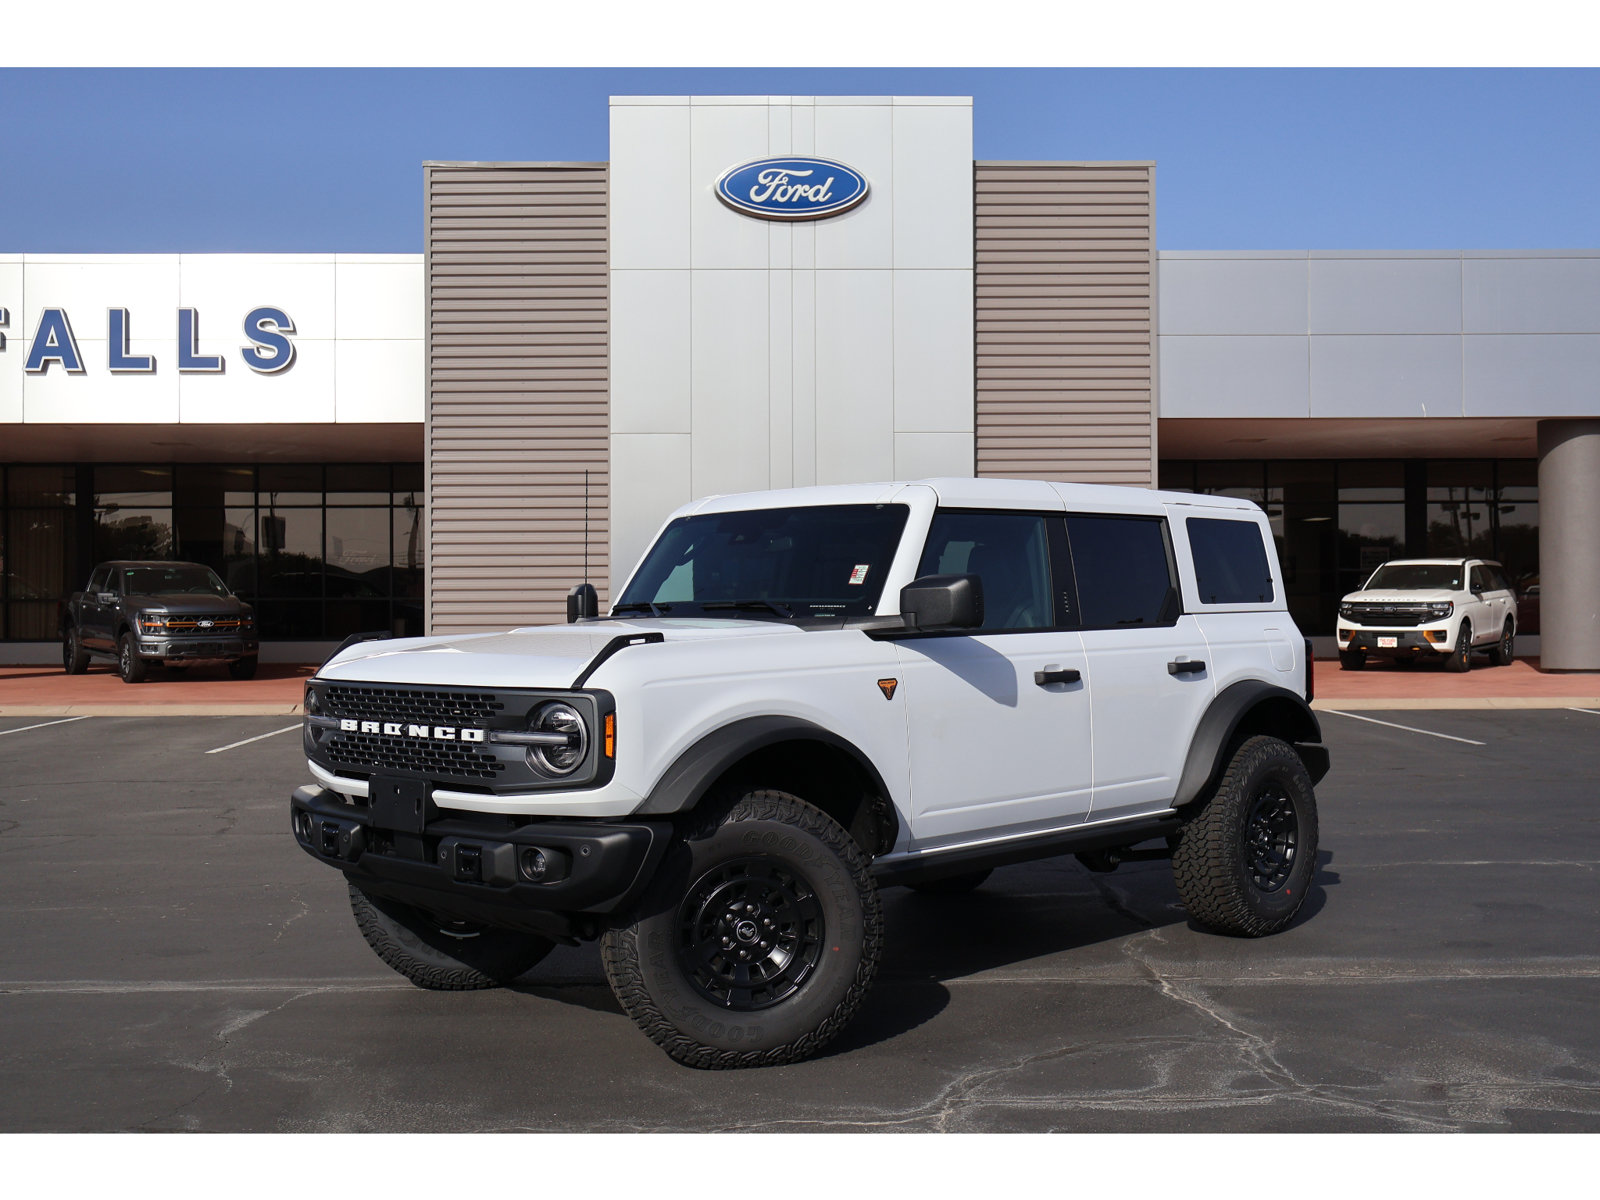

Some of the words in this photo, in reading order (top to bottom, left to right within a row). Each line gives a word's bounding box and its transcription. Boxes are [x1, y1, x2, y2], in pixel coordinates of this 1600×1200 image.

[749, 168, 835, 203] Ford
[0, 305, 297, 376] ALLS
[340, 719, 484, 742] BRONCO
